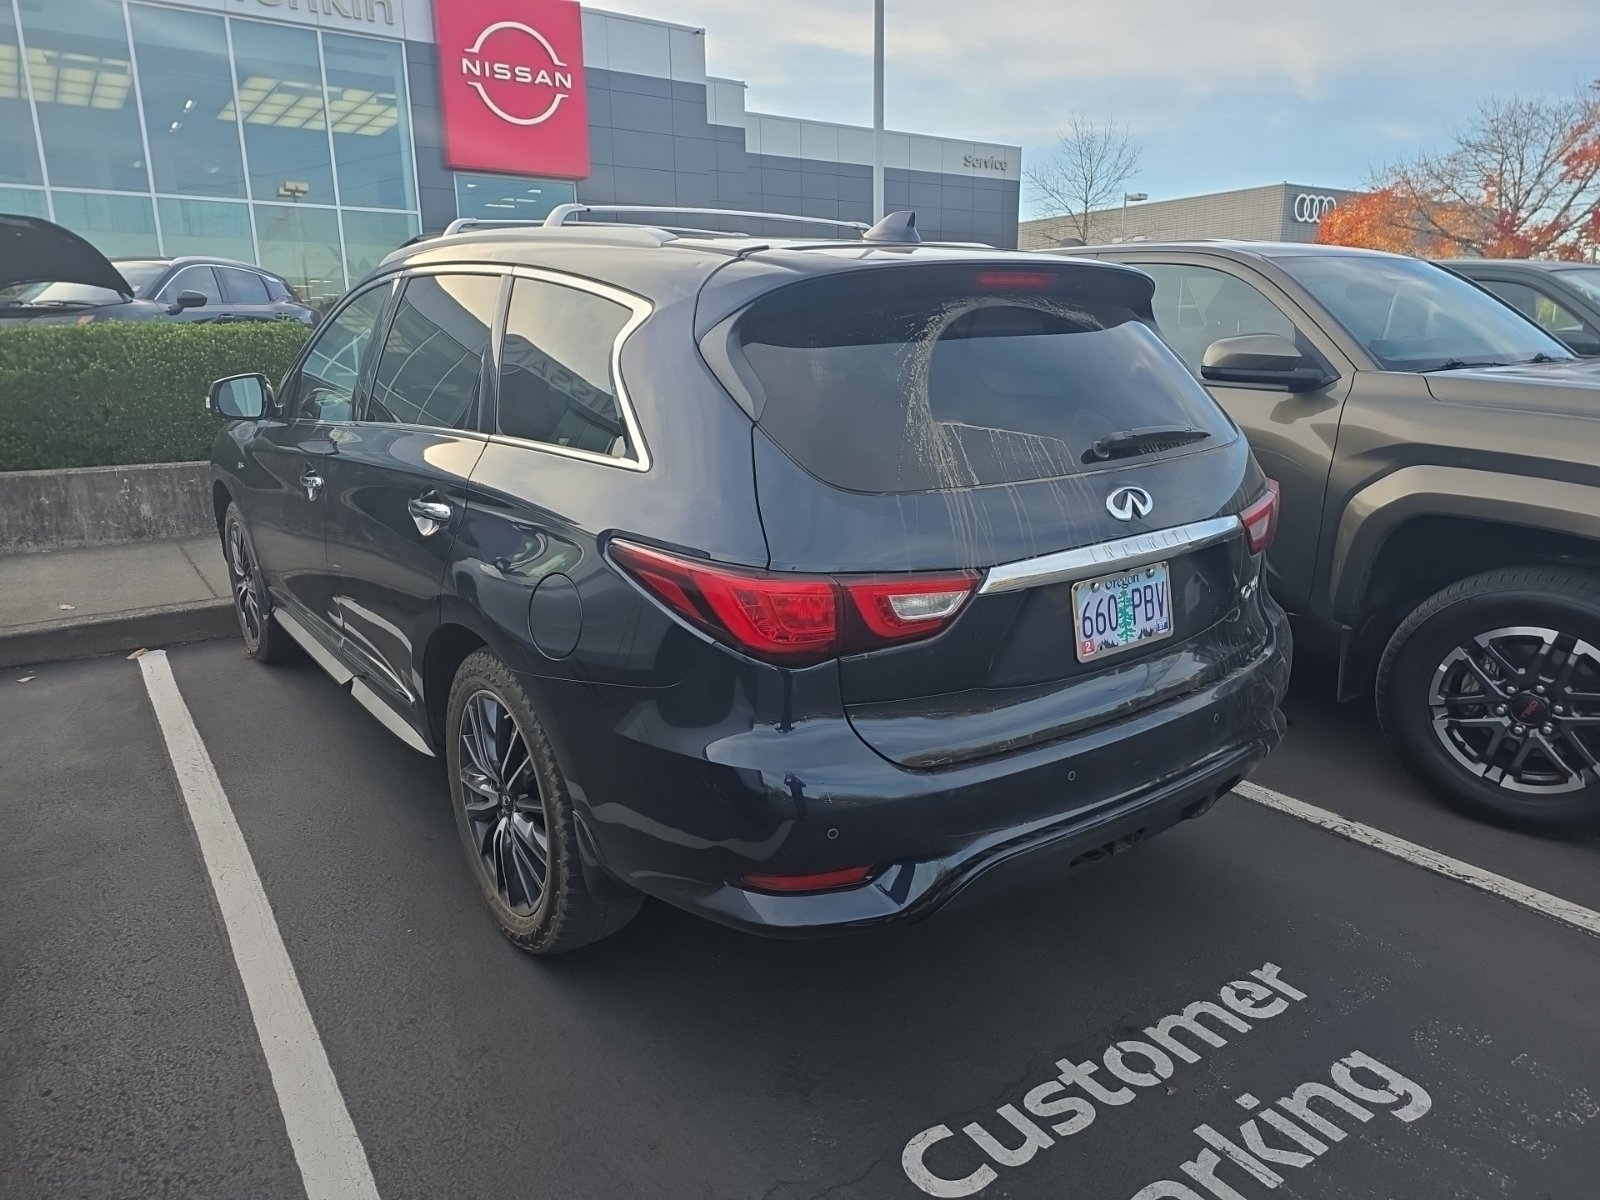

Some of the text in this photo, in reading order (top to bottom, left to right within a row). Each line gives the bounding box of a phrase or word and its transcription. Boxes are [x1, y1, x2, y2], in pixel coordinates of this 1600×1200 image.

[461, 57, 572, 89] NISSAN
[963, 153, 1008, 171] Service
[1088, 528, 1193, 562] INFINITI
[1105, 574, 1140, 589] Oregon
[1082, 581, 1165, 639] 660 PBV
[901, 961, 1308, 1199] Customer
